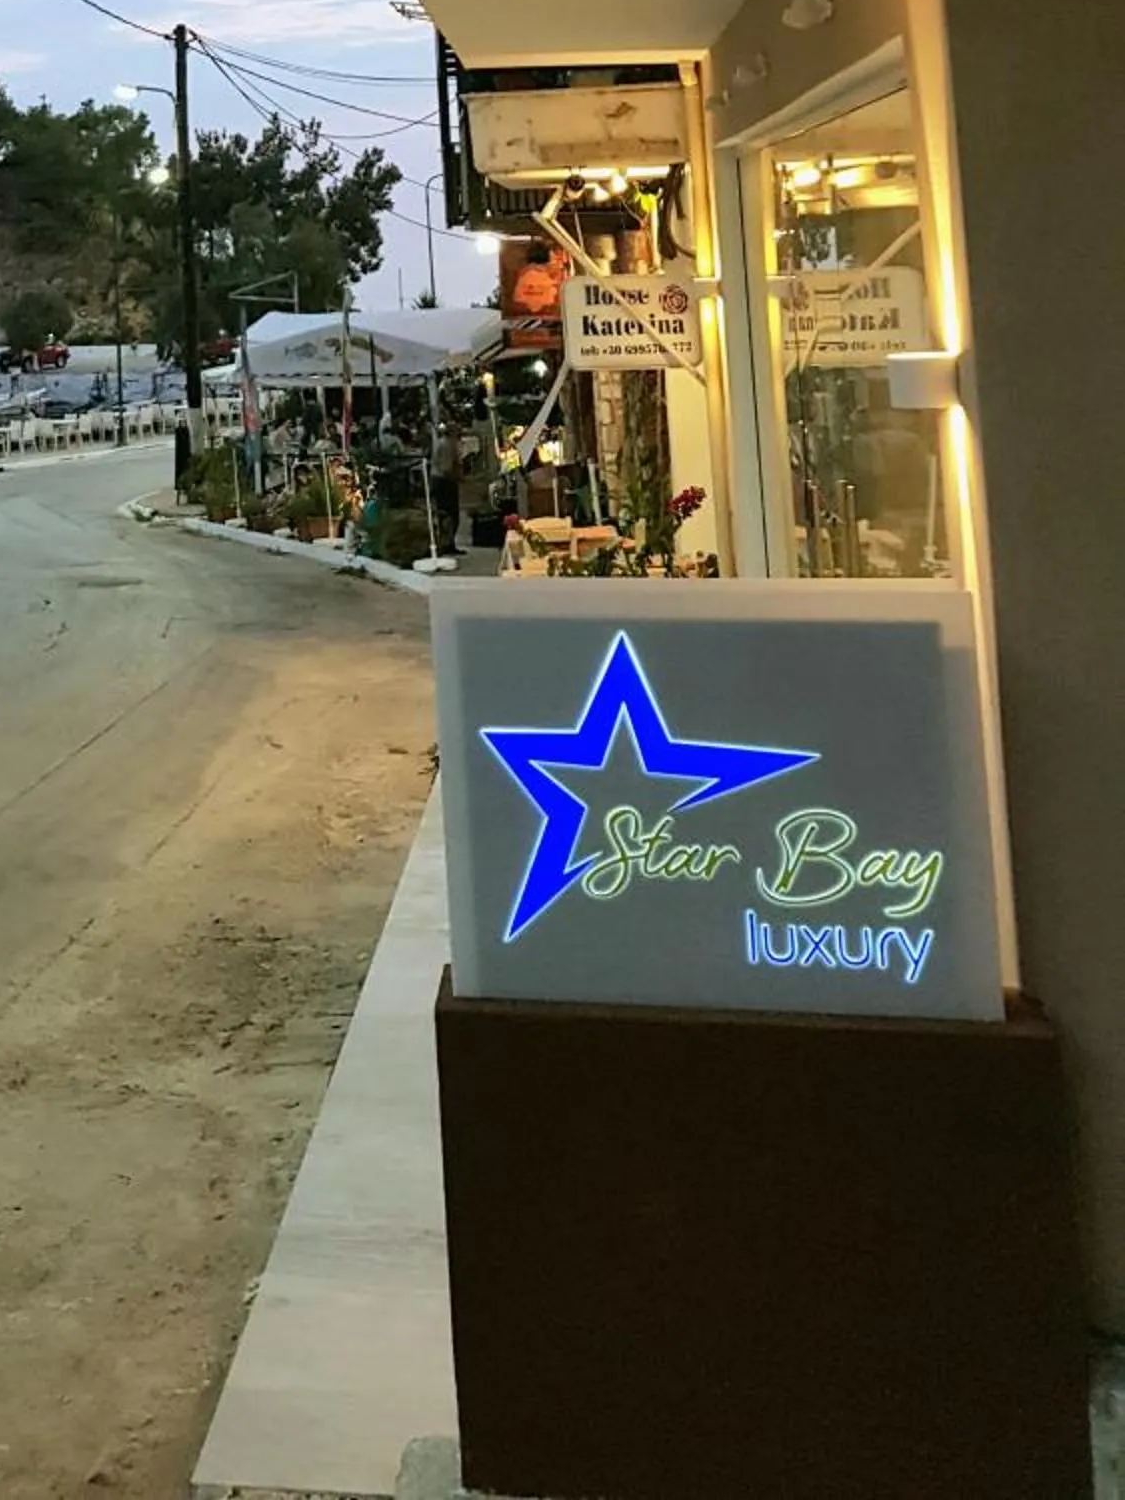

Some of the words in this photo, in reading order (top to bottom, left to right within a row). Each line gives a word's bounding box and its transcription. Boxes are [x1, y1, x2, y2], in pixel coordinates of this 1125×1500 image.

[582, 313, 684, 336] Katerina
[581, 804, 742, 899] Star
[755, 807, 943, 918] Bay
[743, 908, 935, 985] luxury
